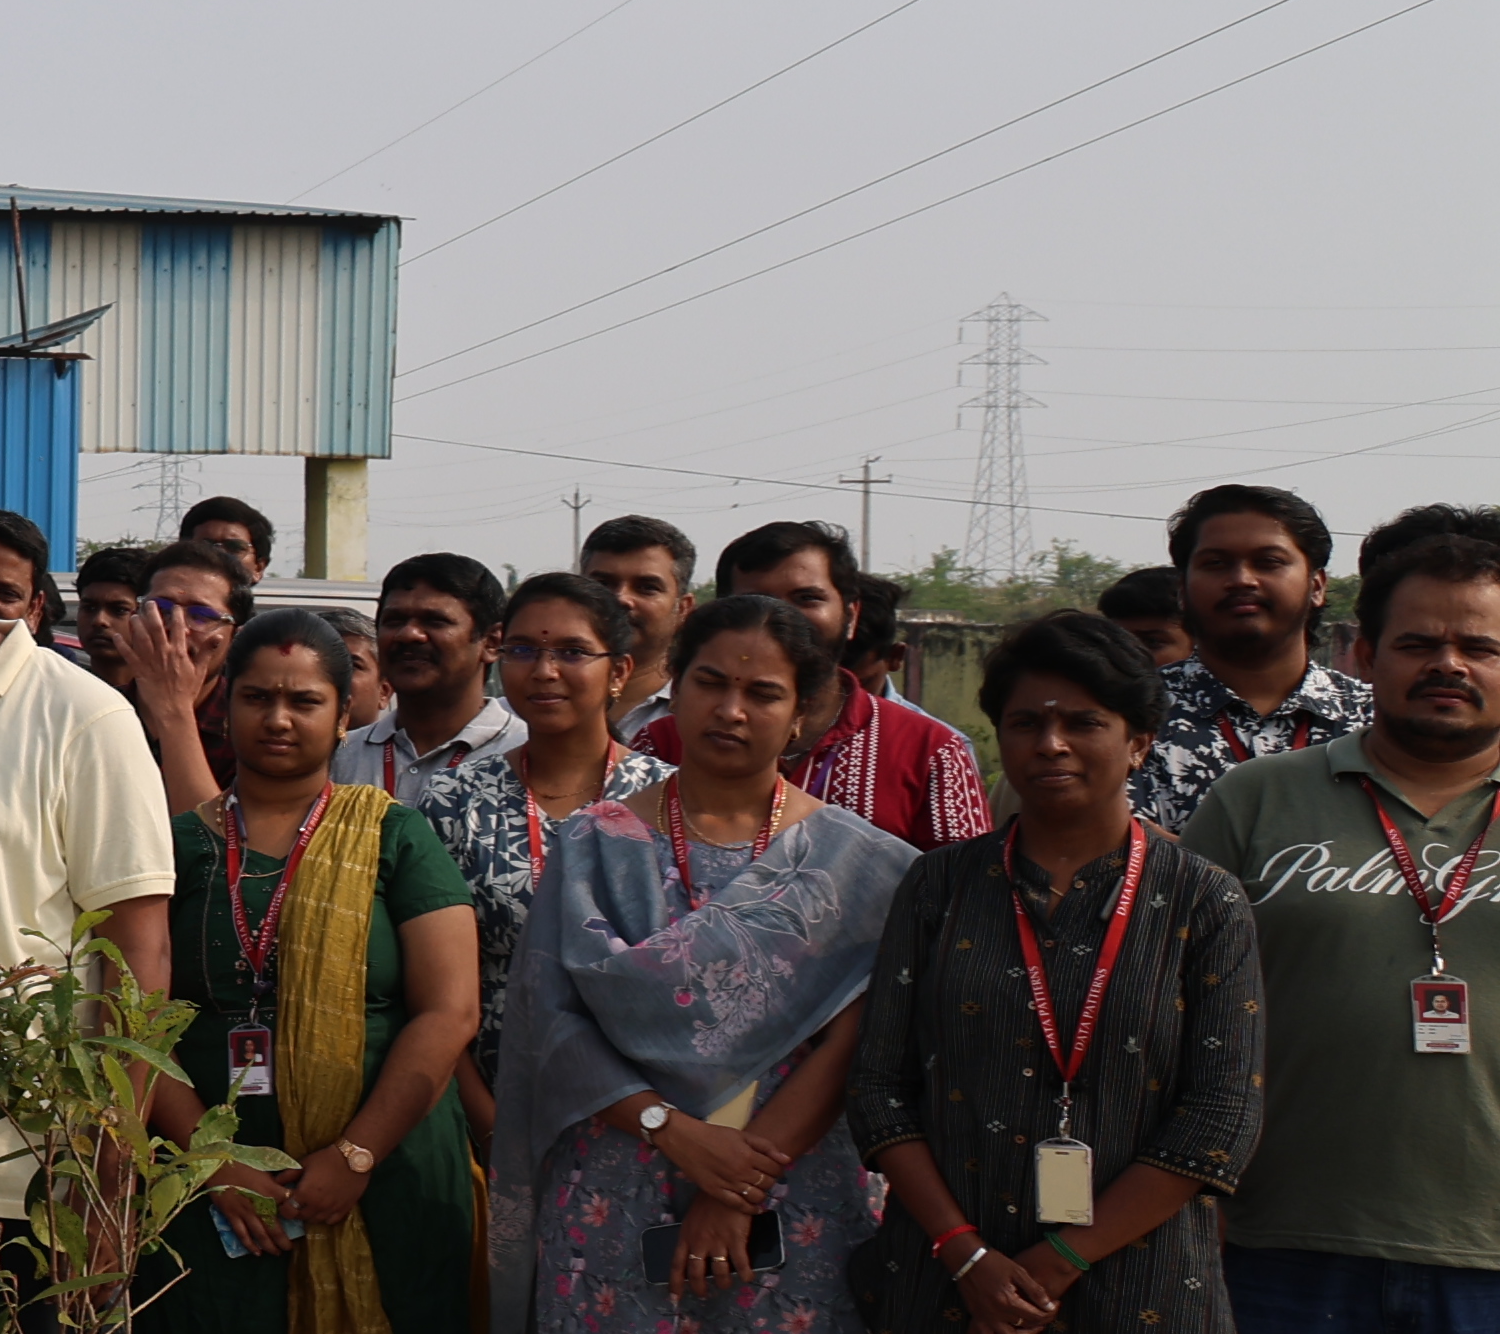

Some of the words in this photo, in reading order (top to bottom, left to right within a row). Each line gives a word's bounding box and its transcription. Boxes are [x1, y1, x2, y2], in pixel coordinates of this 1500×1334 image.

[669, 797, 683, 838] PATTERNS
[673, 838, 687, 865] DATA
[1124, 839, 1142, 889] PATTERNS
[1388, 828, 1414, 874] PATTERNS
[1116, 889, 1134, 916] DATA
[1406, 872, 1425, 900] DATA
[1446, 874, 1467, 901] DATA
[1028, 965, 1050, 1017] PATTERNS
[1082, 968, 1108, 1019] PATTERNS
[1043, 1016, 1057, 1050] DATA
[1074, 1018, 1092, 1052] DATA
